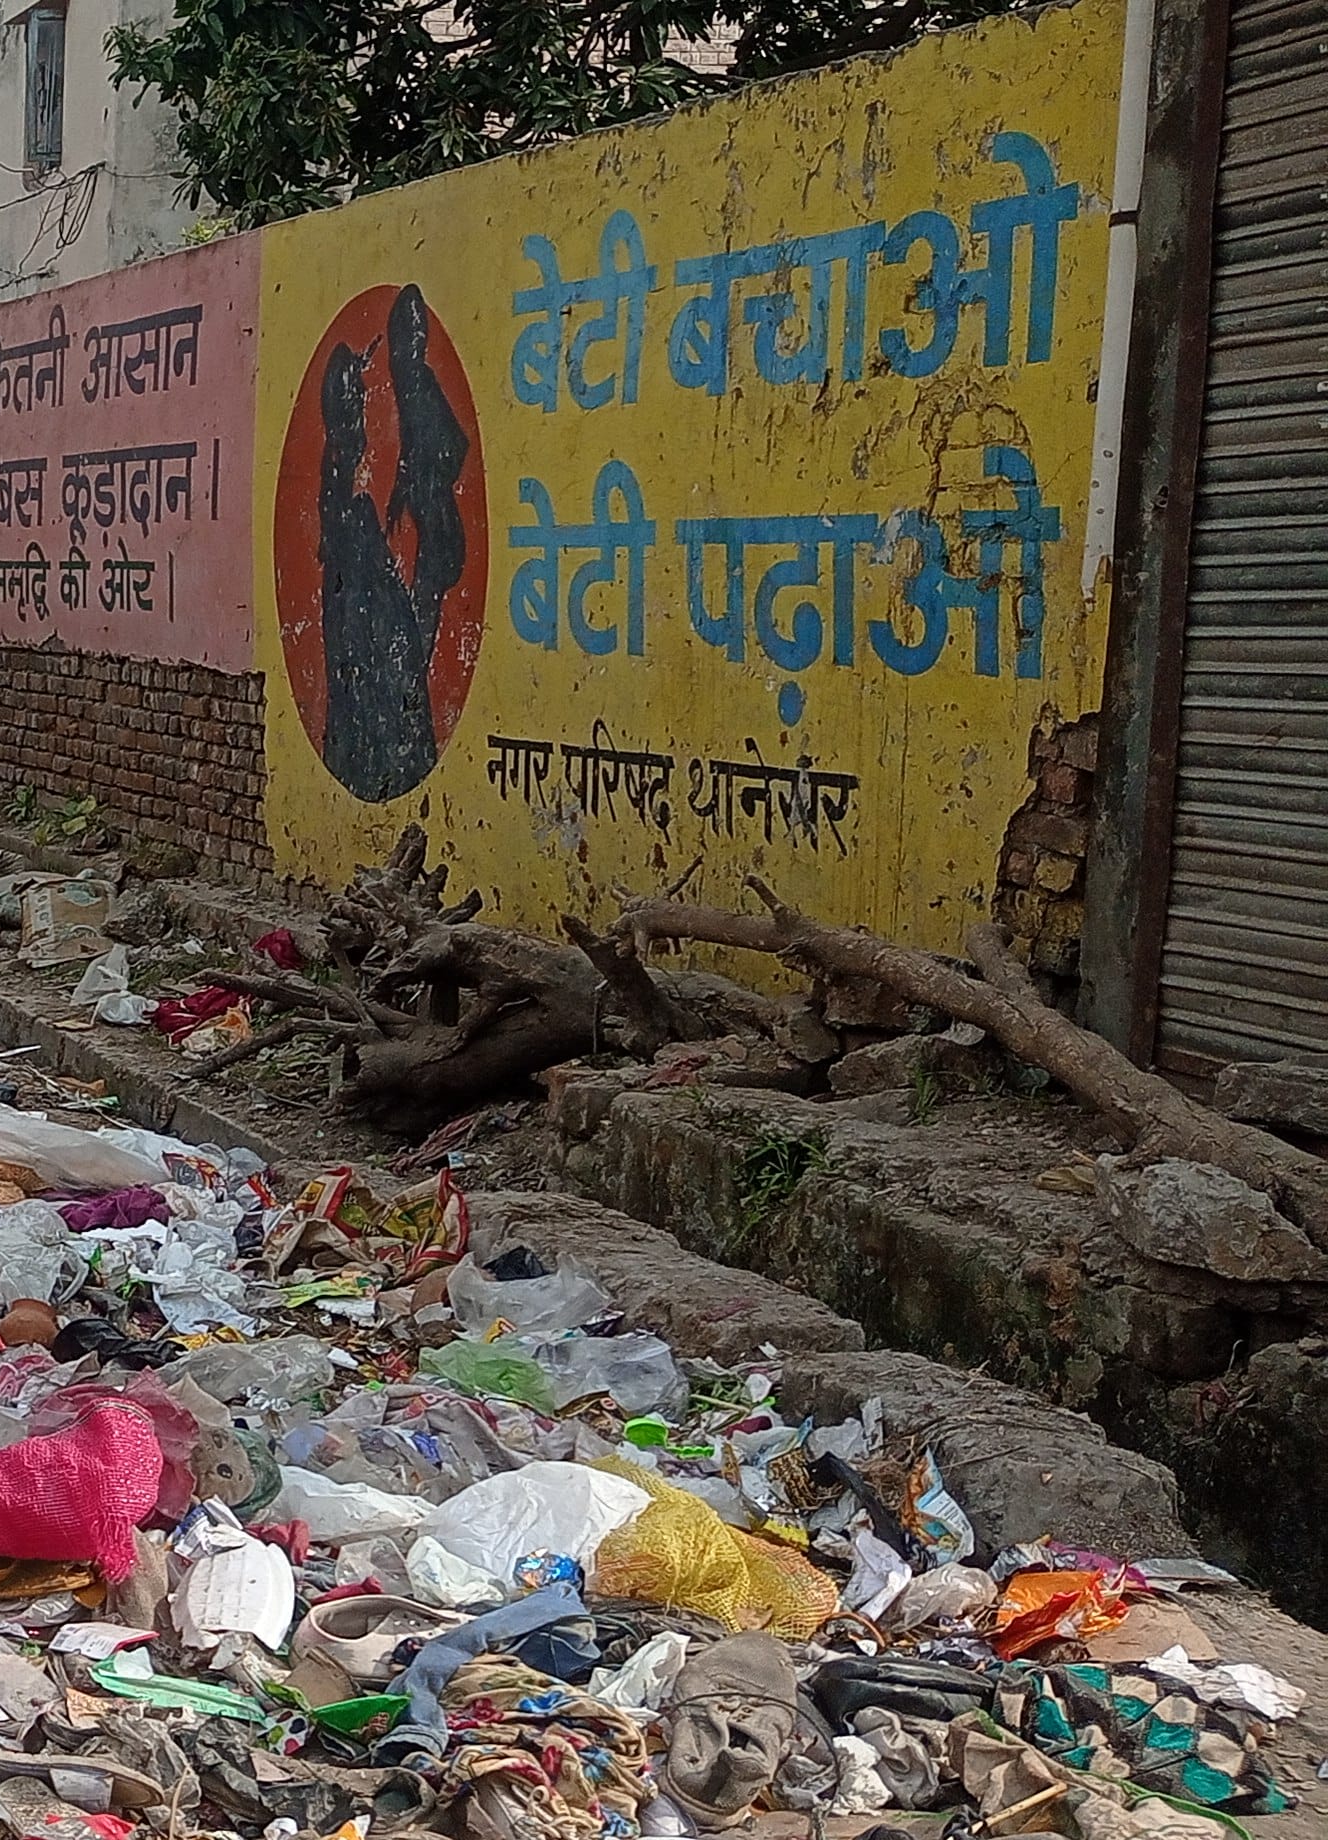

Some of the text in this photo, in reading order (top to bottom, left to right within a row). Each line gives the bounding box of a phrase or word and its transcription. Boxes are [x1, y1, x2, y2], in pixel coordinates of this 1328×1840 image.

[511, 130, 1079, 414] बेटी बचाओ
[81, 304, 203, 403] आसान
[59, 545, 91, 611] की
[508, 445, 1061, 727] बेटी पढ़ाओ
[487, 734, 554, 809] नगर
[560, 718, 675, 846] परिषद
